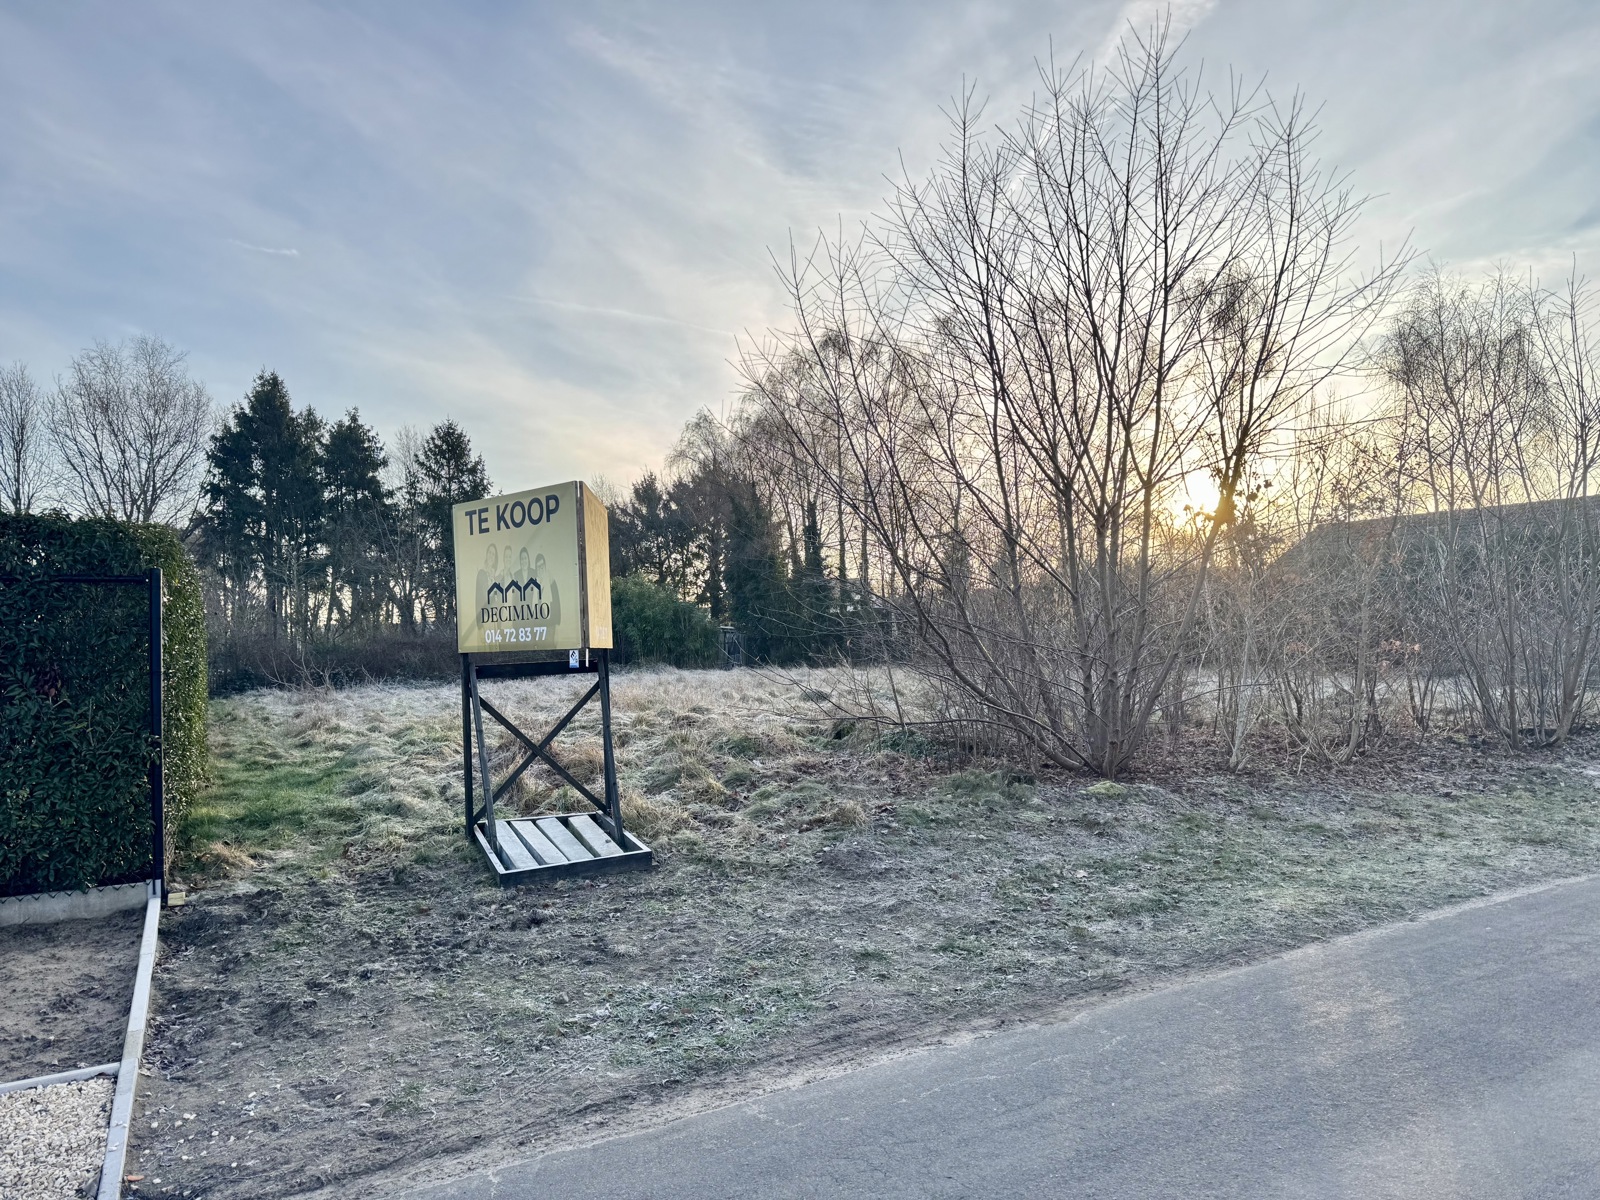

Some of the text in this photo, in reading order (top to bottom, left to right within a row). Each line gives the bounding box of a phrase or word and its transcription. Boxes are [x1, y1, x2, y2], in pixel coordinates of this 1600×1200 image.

[464, 494, 560, 536] TE KOOP
[481, 602, 550, 623] DECIMMO
[485, 626, 547, 643] 014 72 83 77
